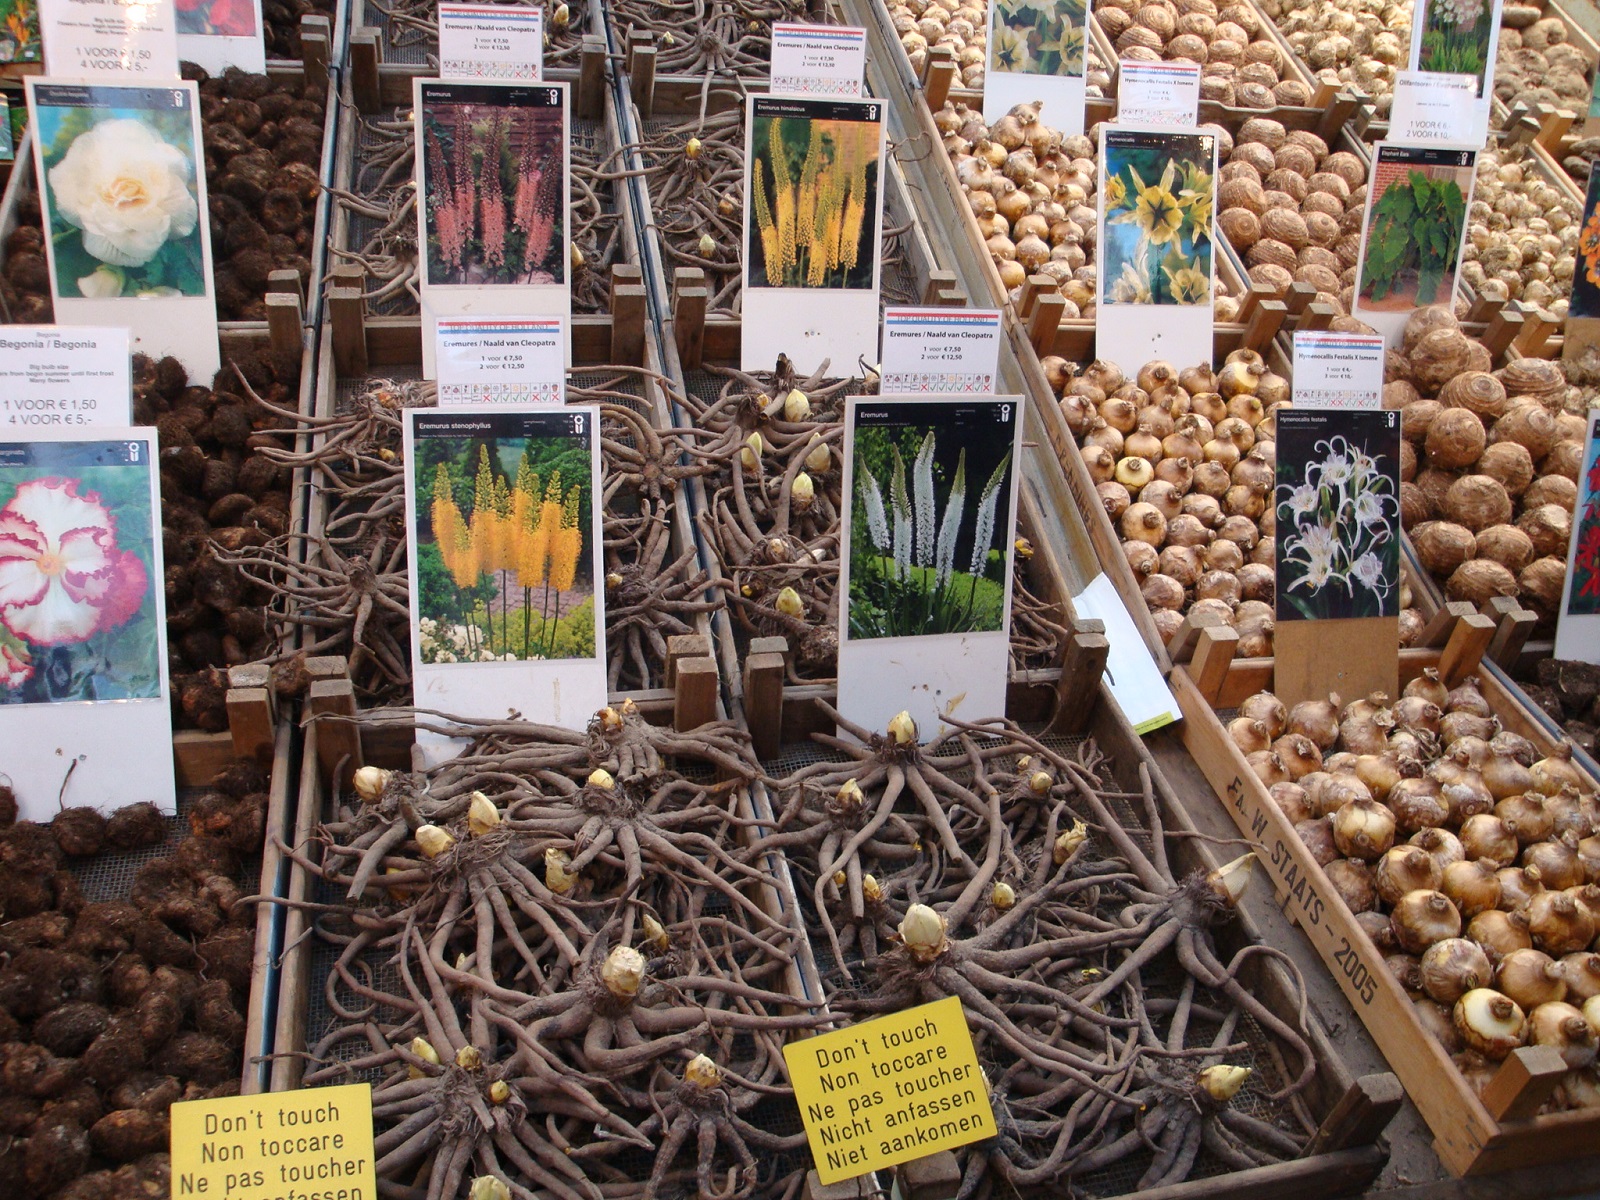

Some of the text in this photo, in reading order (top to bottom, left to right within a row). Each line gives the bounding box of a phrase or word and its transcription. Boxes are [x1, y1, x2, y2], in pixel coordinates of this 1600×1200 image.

[507, 25, 536, 34] Cleopatra
[76, 47, 81, 56] 1
[85, 48, 117, 57] VOOR
[833, 44, 859, 52] Cleopatra
[90, 61, 123, 70] VOOR
[1416, 121, 1435, 129] VOOR
[1412, 130, 1433, 138] VOOR
[961, 332, 993, 340] Cleopatra
[53, 340, 97, 351] Begonia
[520, 340, 556, 348] Cleopatra
[4, 399, 97, 411] 1 VOOR € 1,50
[9, 414, 92, 425] 4 VOOR € 5,-
[860, 411, 889, 419] Eremurus
[419, 422, 491, 432] Eremurus stenophyllus
[1252, 808, 1269, 845] W.
[1271, 840, 1325, 925] STAATS
[1334, 937, 1378, 1005] 2005
[816, 1018, 938, 1069] Don't touch
[819, 1045, 948, 1094] Non toccare
[808, 1064, 972, 1123] Ne pas toucher
[205, 1101, 340, 1135] Don't touch
[819, 1089, 976, 1146] Nicht anfassen
[826, 1114, 984, 1171] Niet aankomen
[202, 1133, 344, 1164] Non toccare
[180, 1156, 366, 1196] Ne pas toucher
